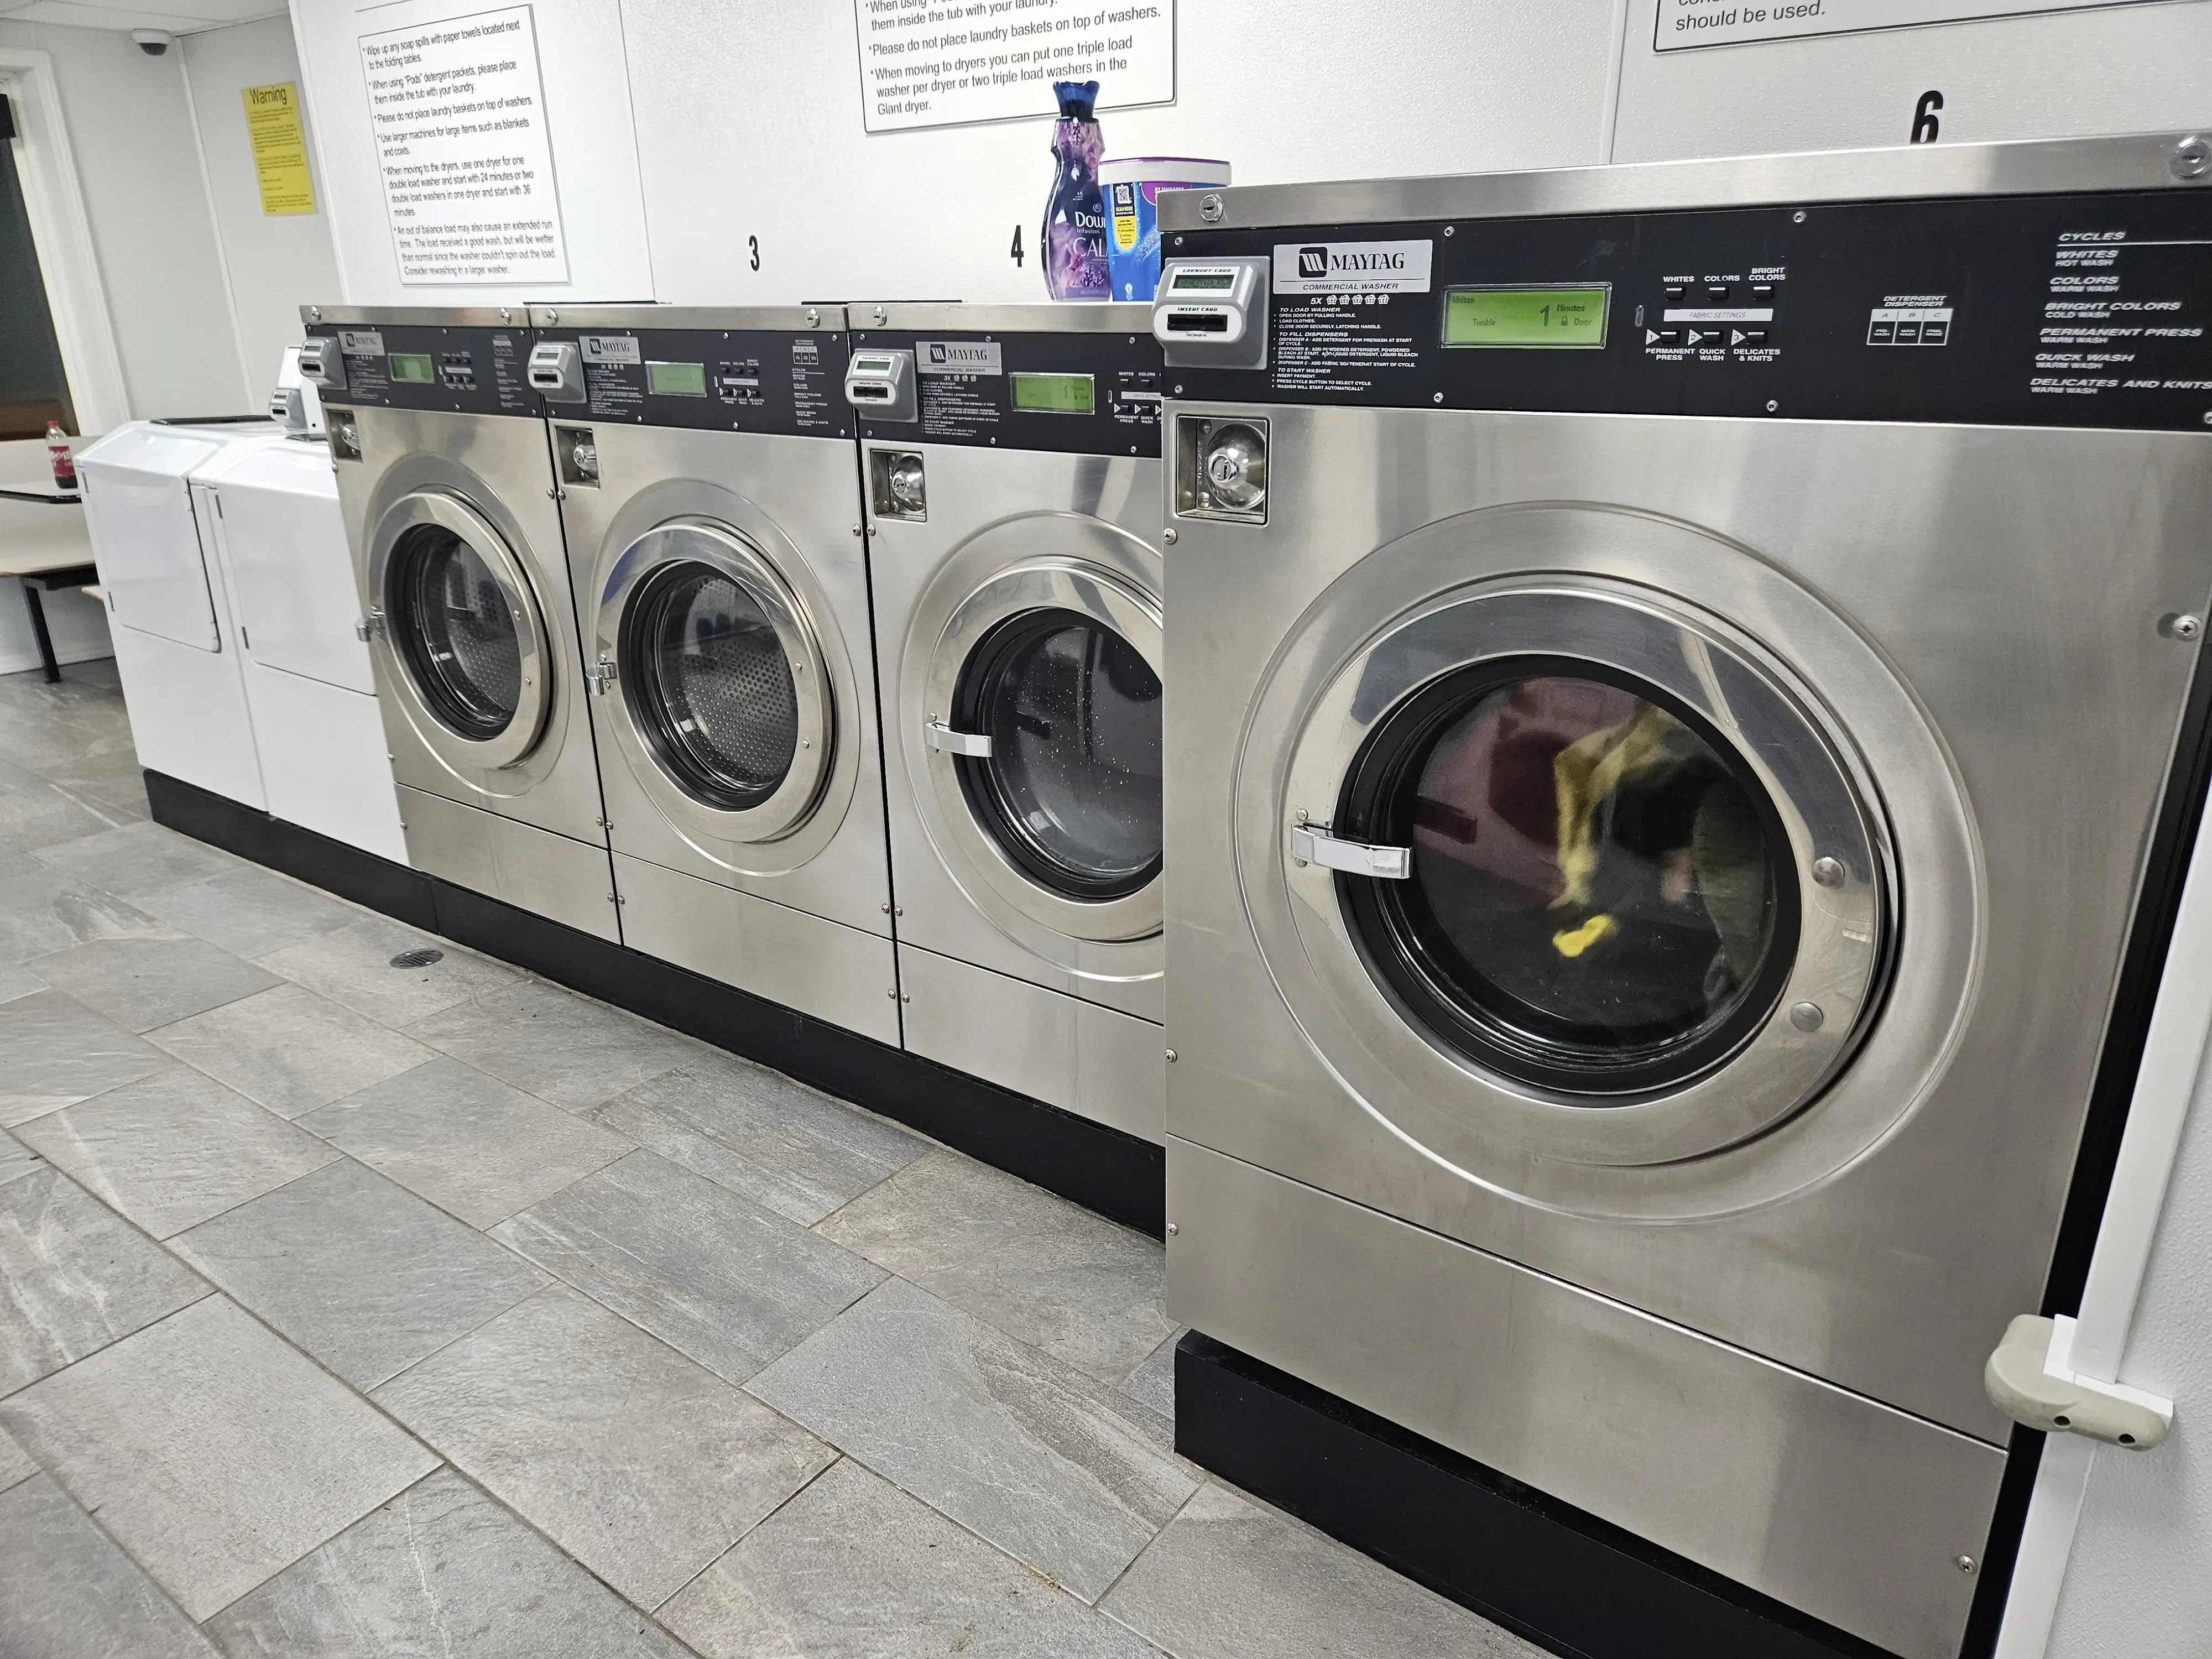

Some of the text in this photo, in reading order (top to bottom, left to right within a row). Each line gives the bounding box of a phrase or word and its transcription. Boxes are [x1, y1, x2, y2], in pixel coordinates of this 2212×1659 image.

[870, 1, 898, 13] When
[872, 18, 895, 31] them
[898, 13, 925, 27] inside
[929, 11, 943, 22] the
[948, 7, 962, 20] tub
[966, 5, 985, 17] with
[990, 1, 1011, 17] your
[1676, 1, 1825, 30] should be used.
[873, 7, 1161, 56] Please do not place laundry baskets on top of washers.
[875, 35, 1132, 80] When moving to dryers you can put one triple load
[877, 57, 1126, 98] washer per dryer or two triple load washers in the
[249, 86, 287, 105] Warning
[377, 113, 396, 123] Please
[397, 111, 404, 121] do
[405, 111, 414, 120] not
[415, 109, 430, 121] place
[431, 106, 452, 117] laundry
[453, 103, 476, 114] baskets
[486, 101, 496, 110] top
[498, 98, 503, 108] of
[505, 95, 533, 107] washers.
[878, 101, 931, 115] Giant dryer.
[1910, 90, 1943, 144] 6
[1075, 212, 1105, 227] Dow
[2058, 232, 2126, 241] CYCLES
[749, 236, 760, 272] 3
[1011, 225, 1024, 268] 4
[1073, 237, 1108, 257] CAL
[2056, 250, 2120, 258] WHITES
[1331, 253, 1404, 270] MAYTAG
[1541, 305, 1550, 326] 1
[2110, 302, 2182, 310] COLORS
[2144, 328, 2204, 337] PRESS
[602, 342, 629, 352] MAYTAG
[947, 349, 987, 360] MAYTAG
[2030, 378, 2119, 387] DELICATES
